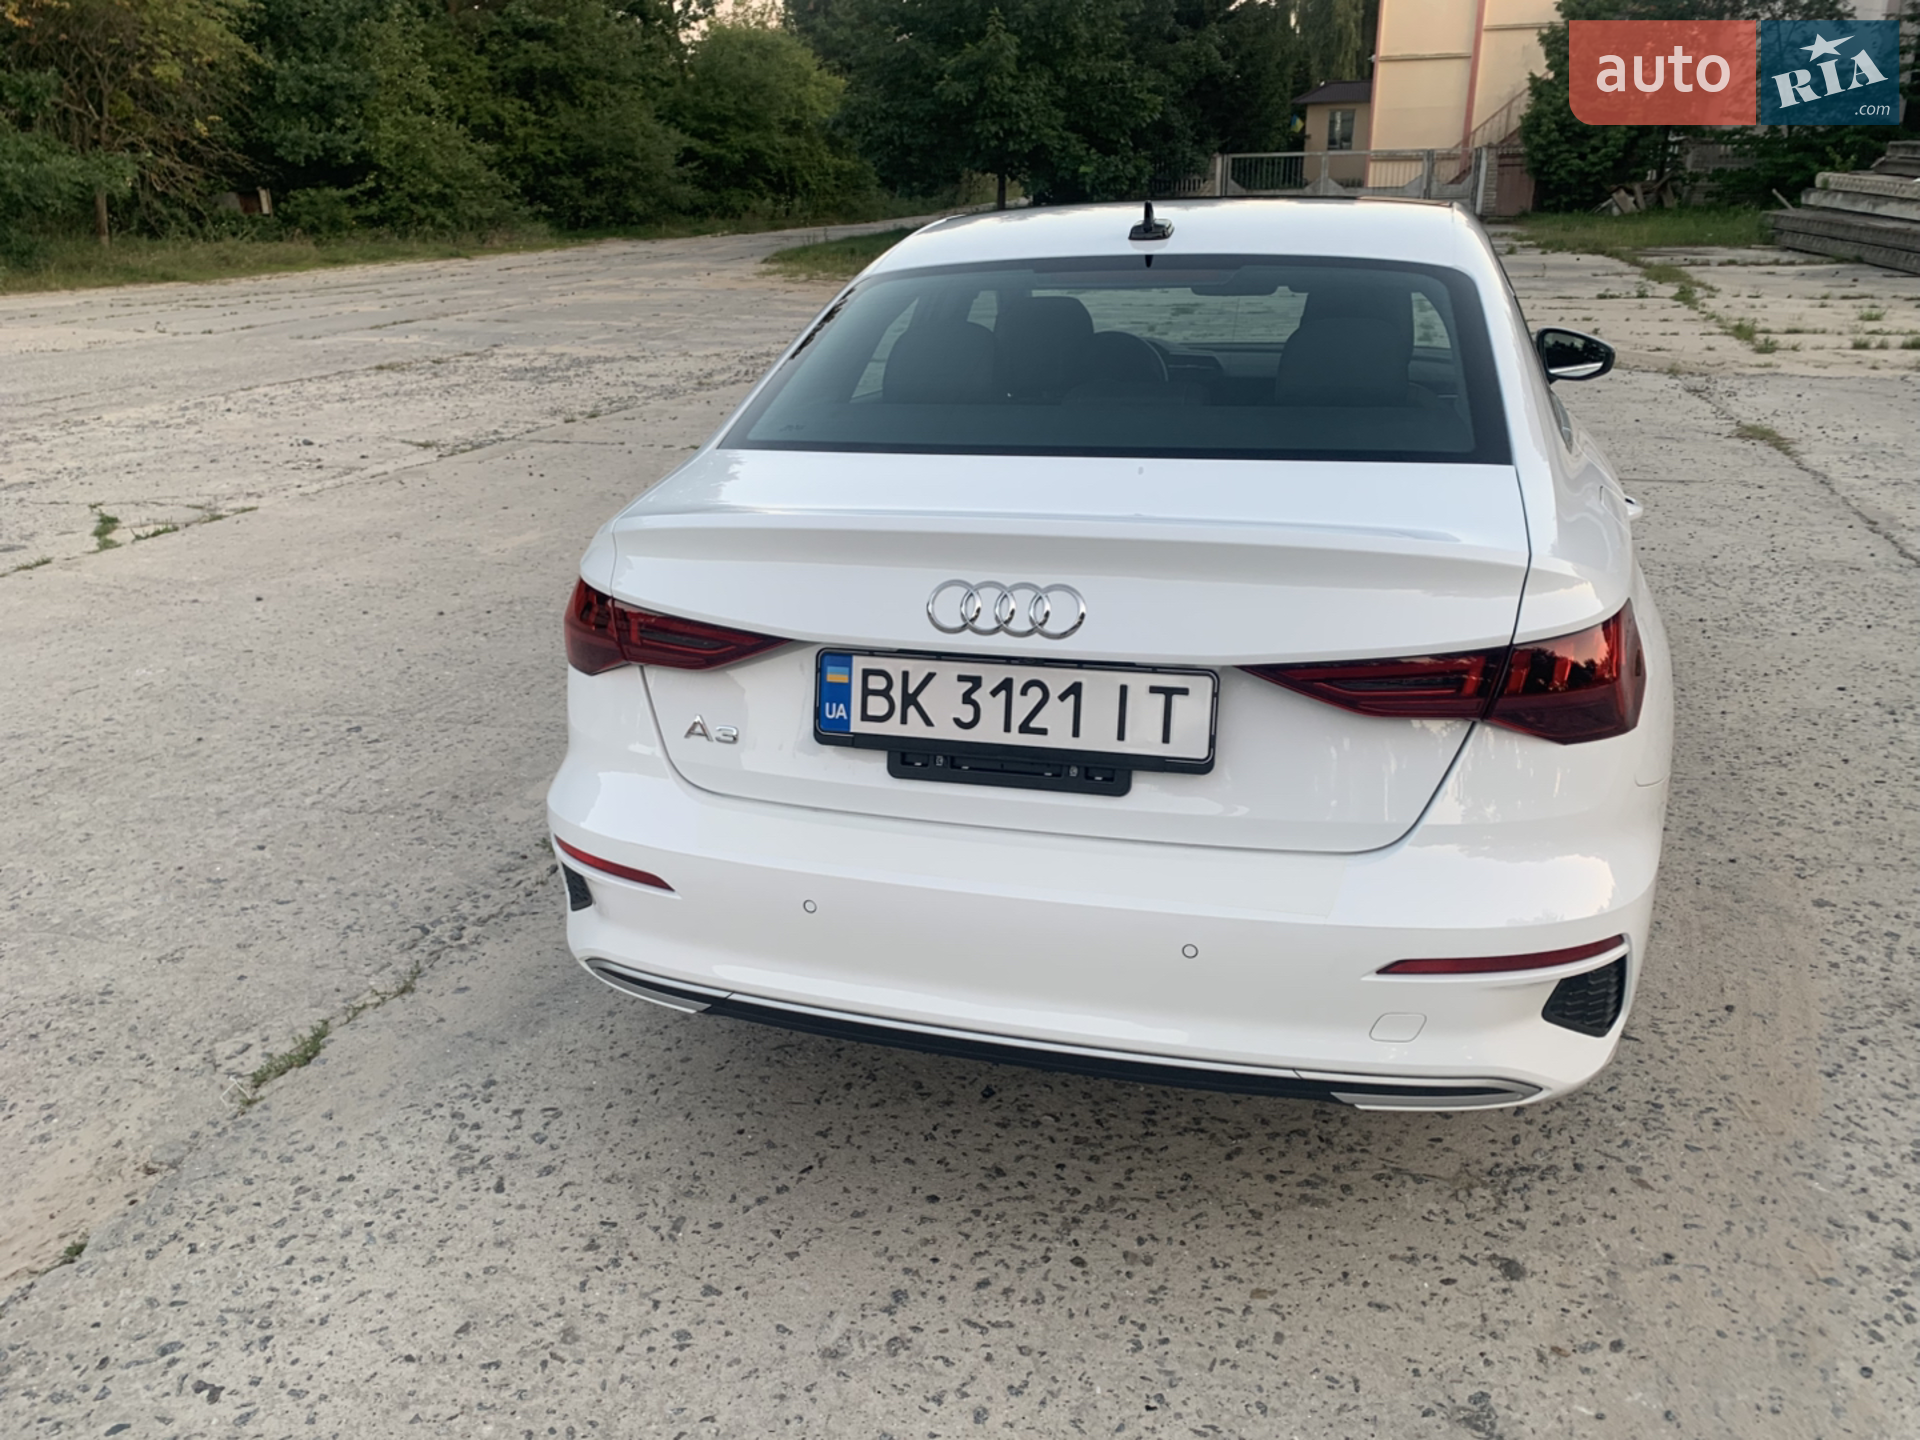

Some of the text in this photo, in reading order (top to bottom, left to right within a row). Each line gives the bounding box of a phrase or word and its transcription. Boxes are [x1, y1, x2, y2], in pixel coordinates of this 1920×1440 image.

[825, 702, 848, 720] UA
[859, 667, 1190, 744] BK 3121 IT
[684, 714, 739, 744] A3
